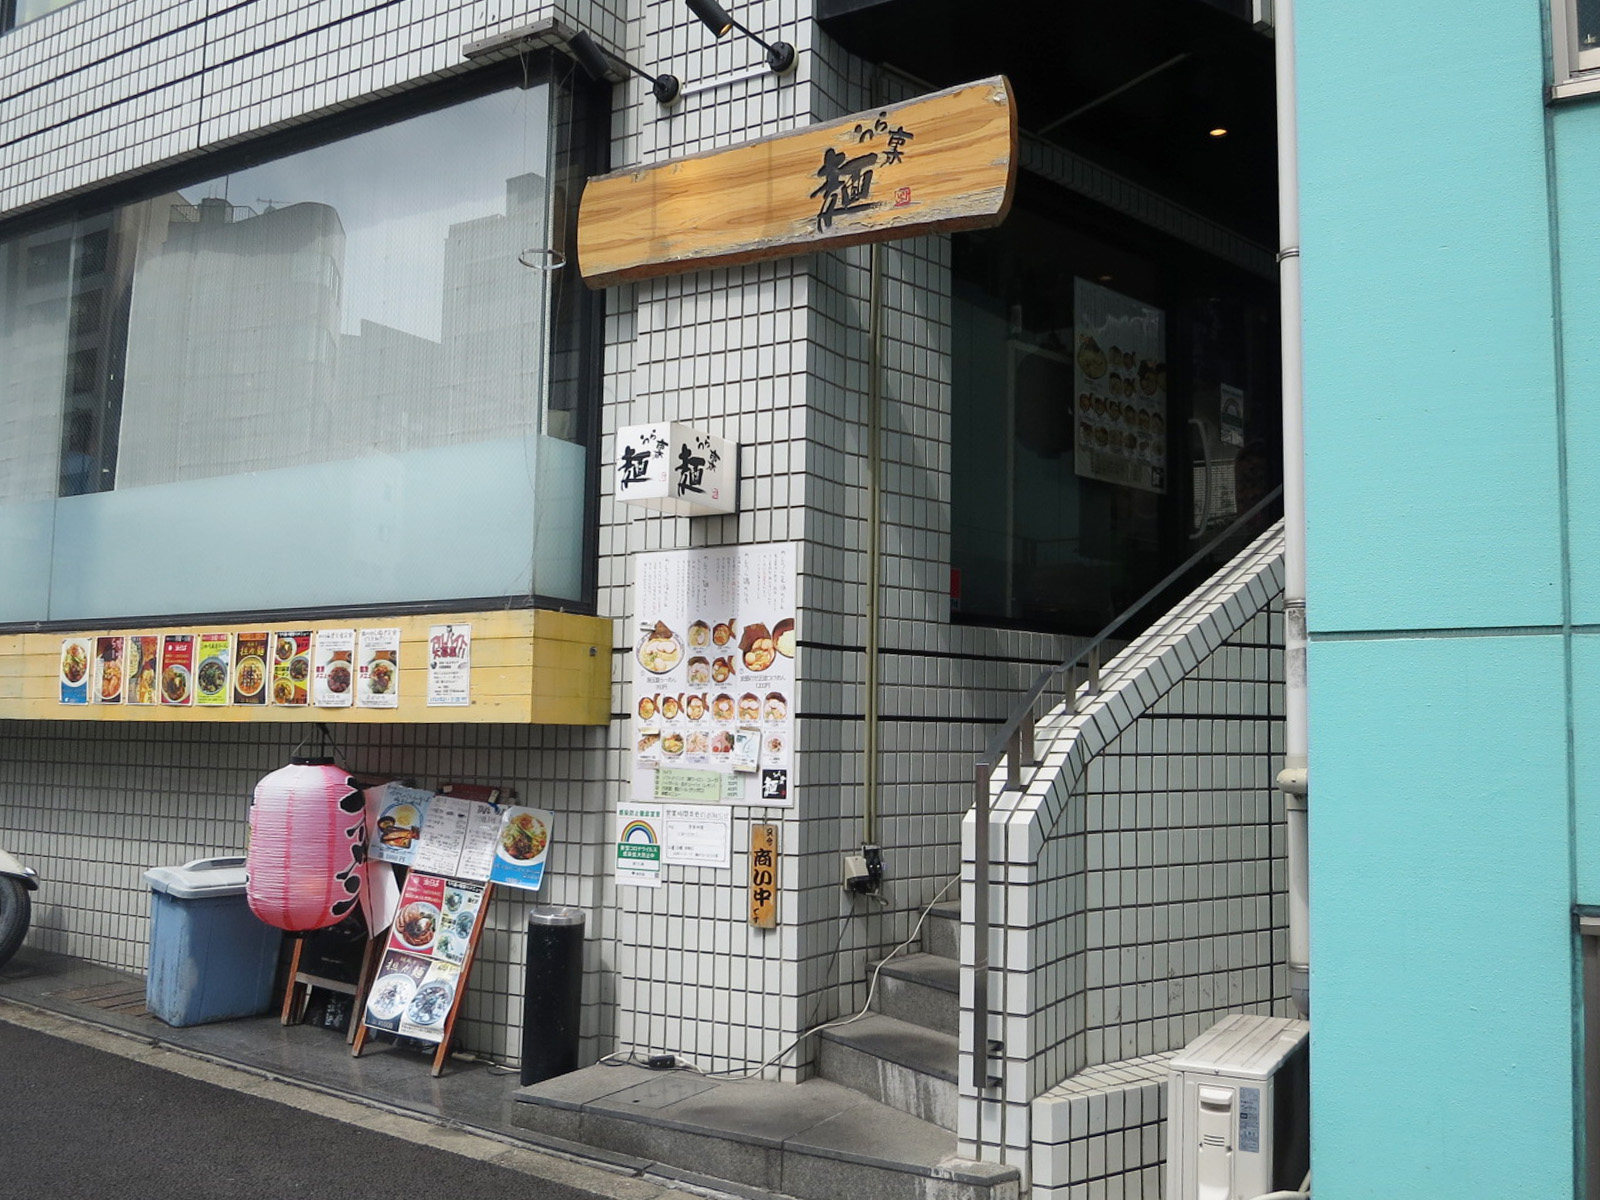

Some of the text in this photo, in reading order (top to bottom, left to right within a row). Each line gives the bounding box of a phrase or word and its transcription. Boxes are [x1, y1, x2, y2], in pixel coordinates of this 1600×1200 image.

[753, 848, 772, 908] 商い中
[385, 958, 426, 979] 担々麺
